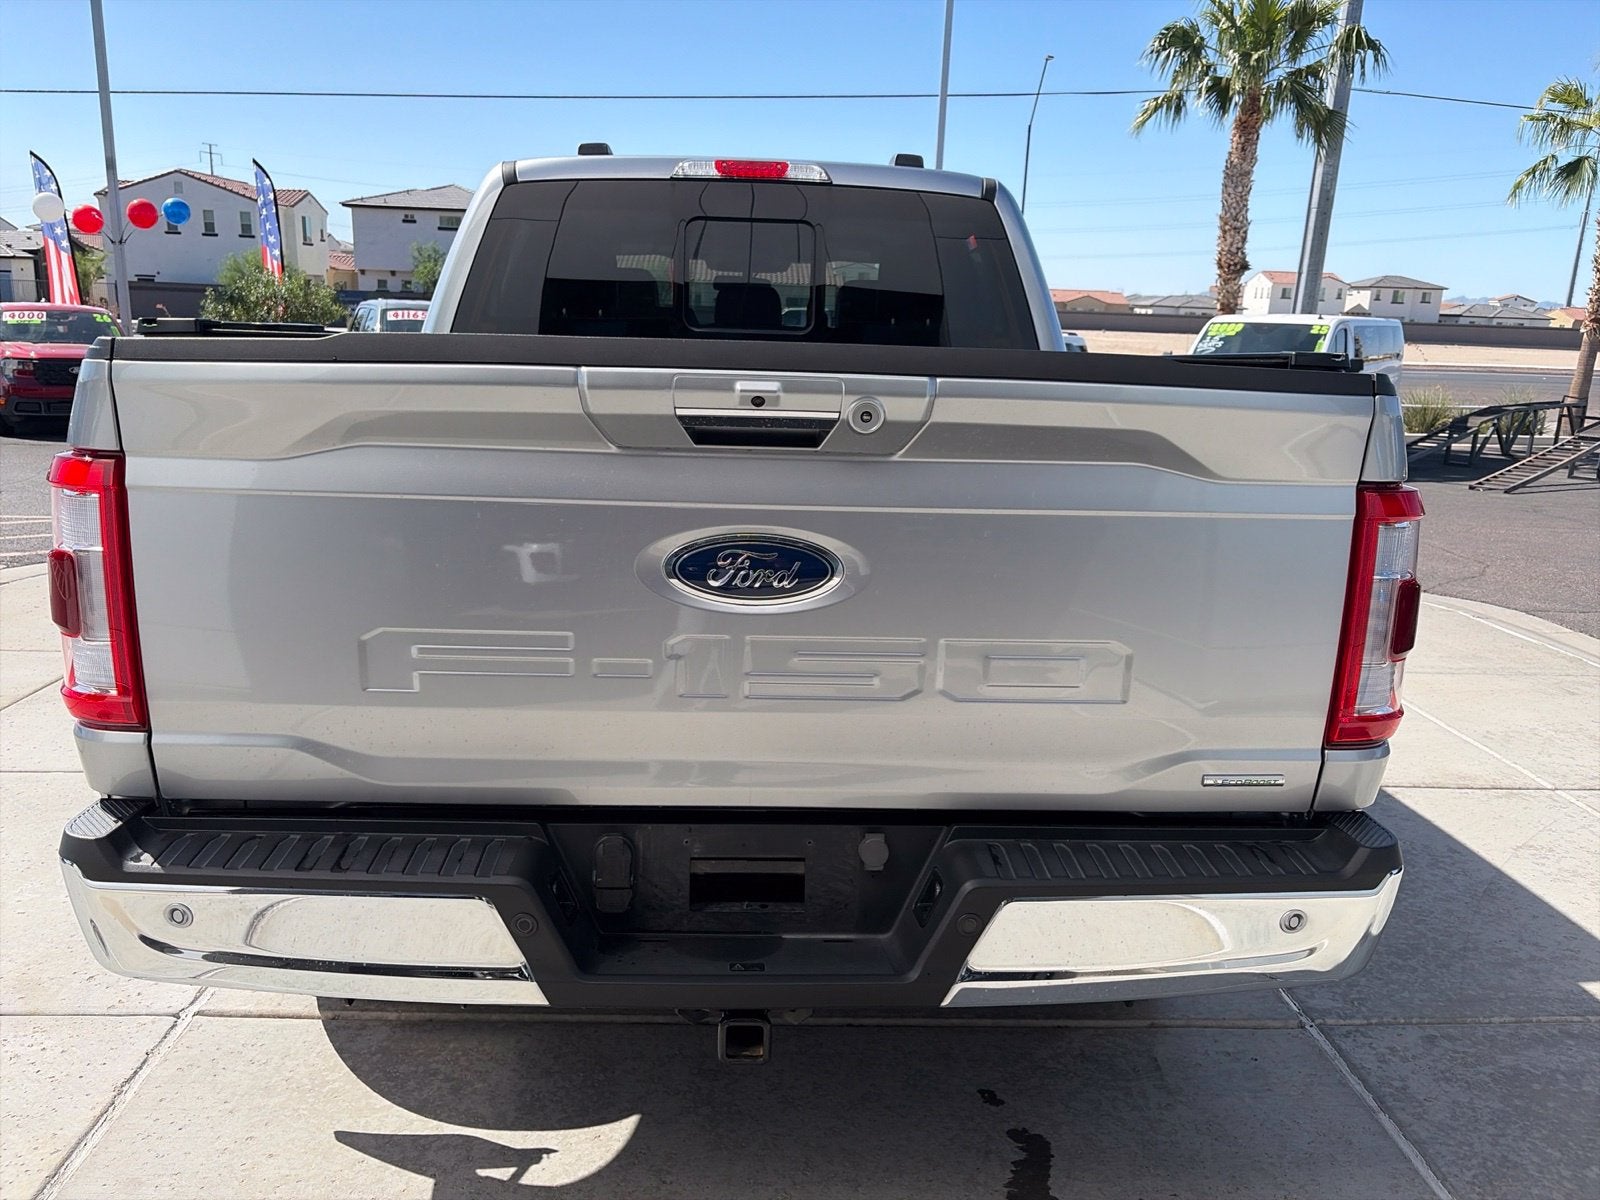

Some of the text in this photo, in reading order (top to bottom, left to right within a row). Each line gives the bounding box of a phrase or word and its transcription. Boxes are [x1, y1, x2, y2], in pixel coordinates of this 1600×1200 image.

[1310, 325, 1330, 335] 25
[706, 549, 801, 588] Ford
[359, 627, 1135, 704] F-150
